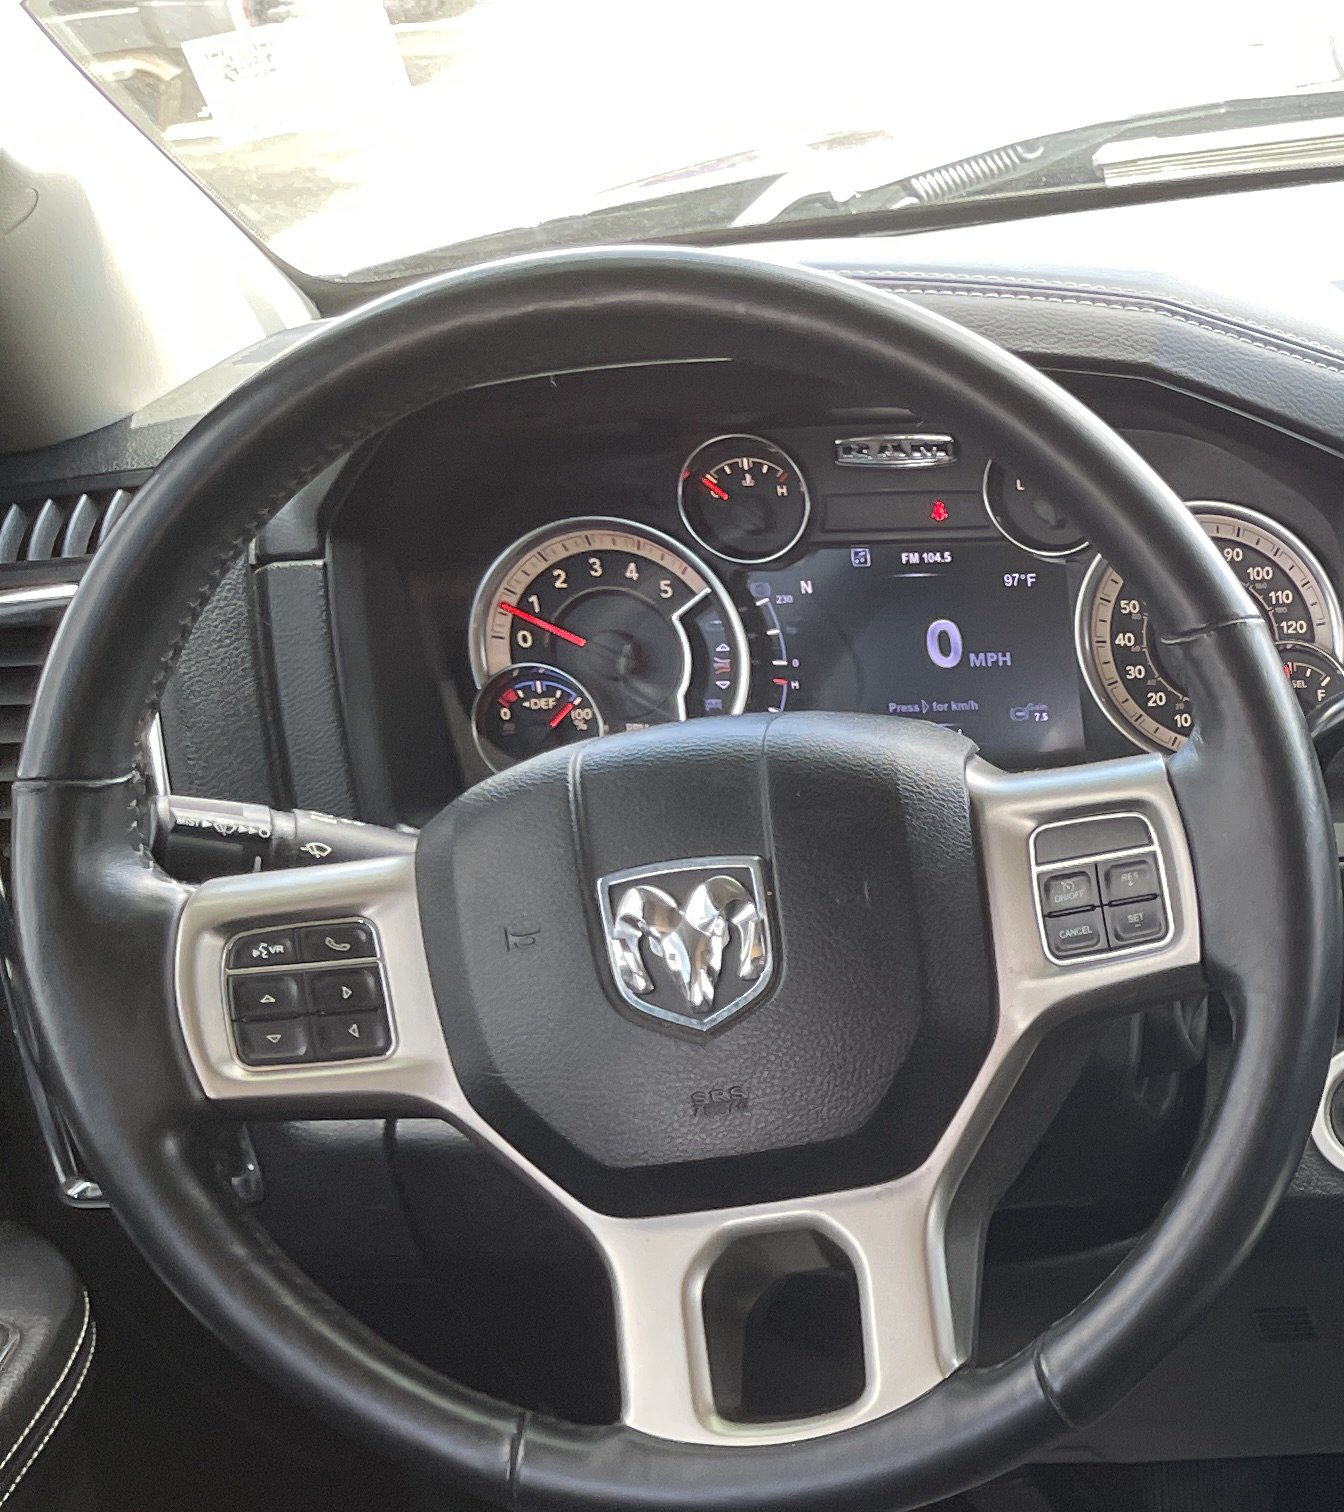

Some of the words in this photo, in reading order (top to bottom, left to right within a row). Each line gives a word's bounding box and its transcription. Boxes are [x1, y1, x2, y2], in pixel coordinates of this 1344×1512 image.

[776, 485, 788, 497] H
[1015, 479, 1025, 491] L
[902, 552, 919, 565] FM
[922, 551, 952, 564] 104.5
[1224, 548, 1243, 562] 90
[588, 557, 602, 578] 3
[625, 562, 639, 581] 4
[1247, 567, 1273, 581] 100
[553, 569, 568, 589] 2
[1004, 573, 1037, 587] 97°F
[659, 580, 673, 599] 5
[801, 580, 813, 594] N
[527, 594, 541, 611] 1
[1269, 590, 1293, 605] 110
[1120, 600, 1140, 614] 50
[1280, 620, 1307, 634] 120
[517, 630, 532, 648] 0
[926, 619, 963, 669] 0
[1115, 632, 1135, 647] 40
[969, 652, 1012, 668] MPH
[1126, 665, 1146, 679] 30
[1147, 692, 1167, 707] 20
[1317, 689, 1326, 701] F
[531, 698, 556, 710] DEF
[888, 702, 920, 713] Press
[932, 701, 949, 712] for
[951, 700, 979, 711] km/h
[500, 708, 511, 720] 0
[1174, 713, 1192, 728] 10
[1121, 871, 1139, 882] RES
[1127, 912, 1144, 923] SET
[1059, 926, 1093, 939] CANCEL
[268, 944, 284, 955] VR
[691, 1086, 746, 1105] SRS
